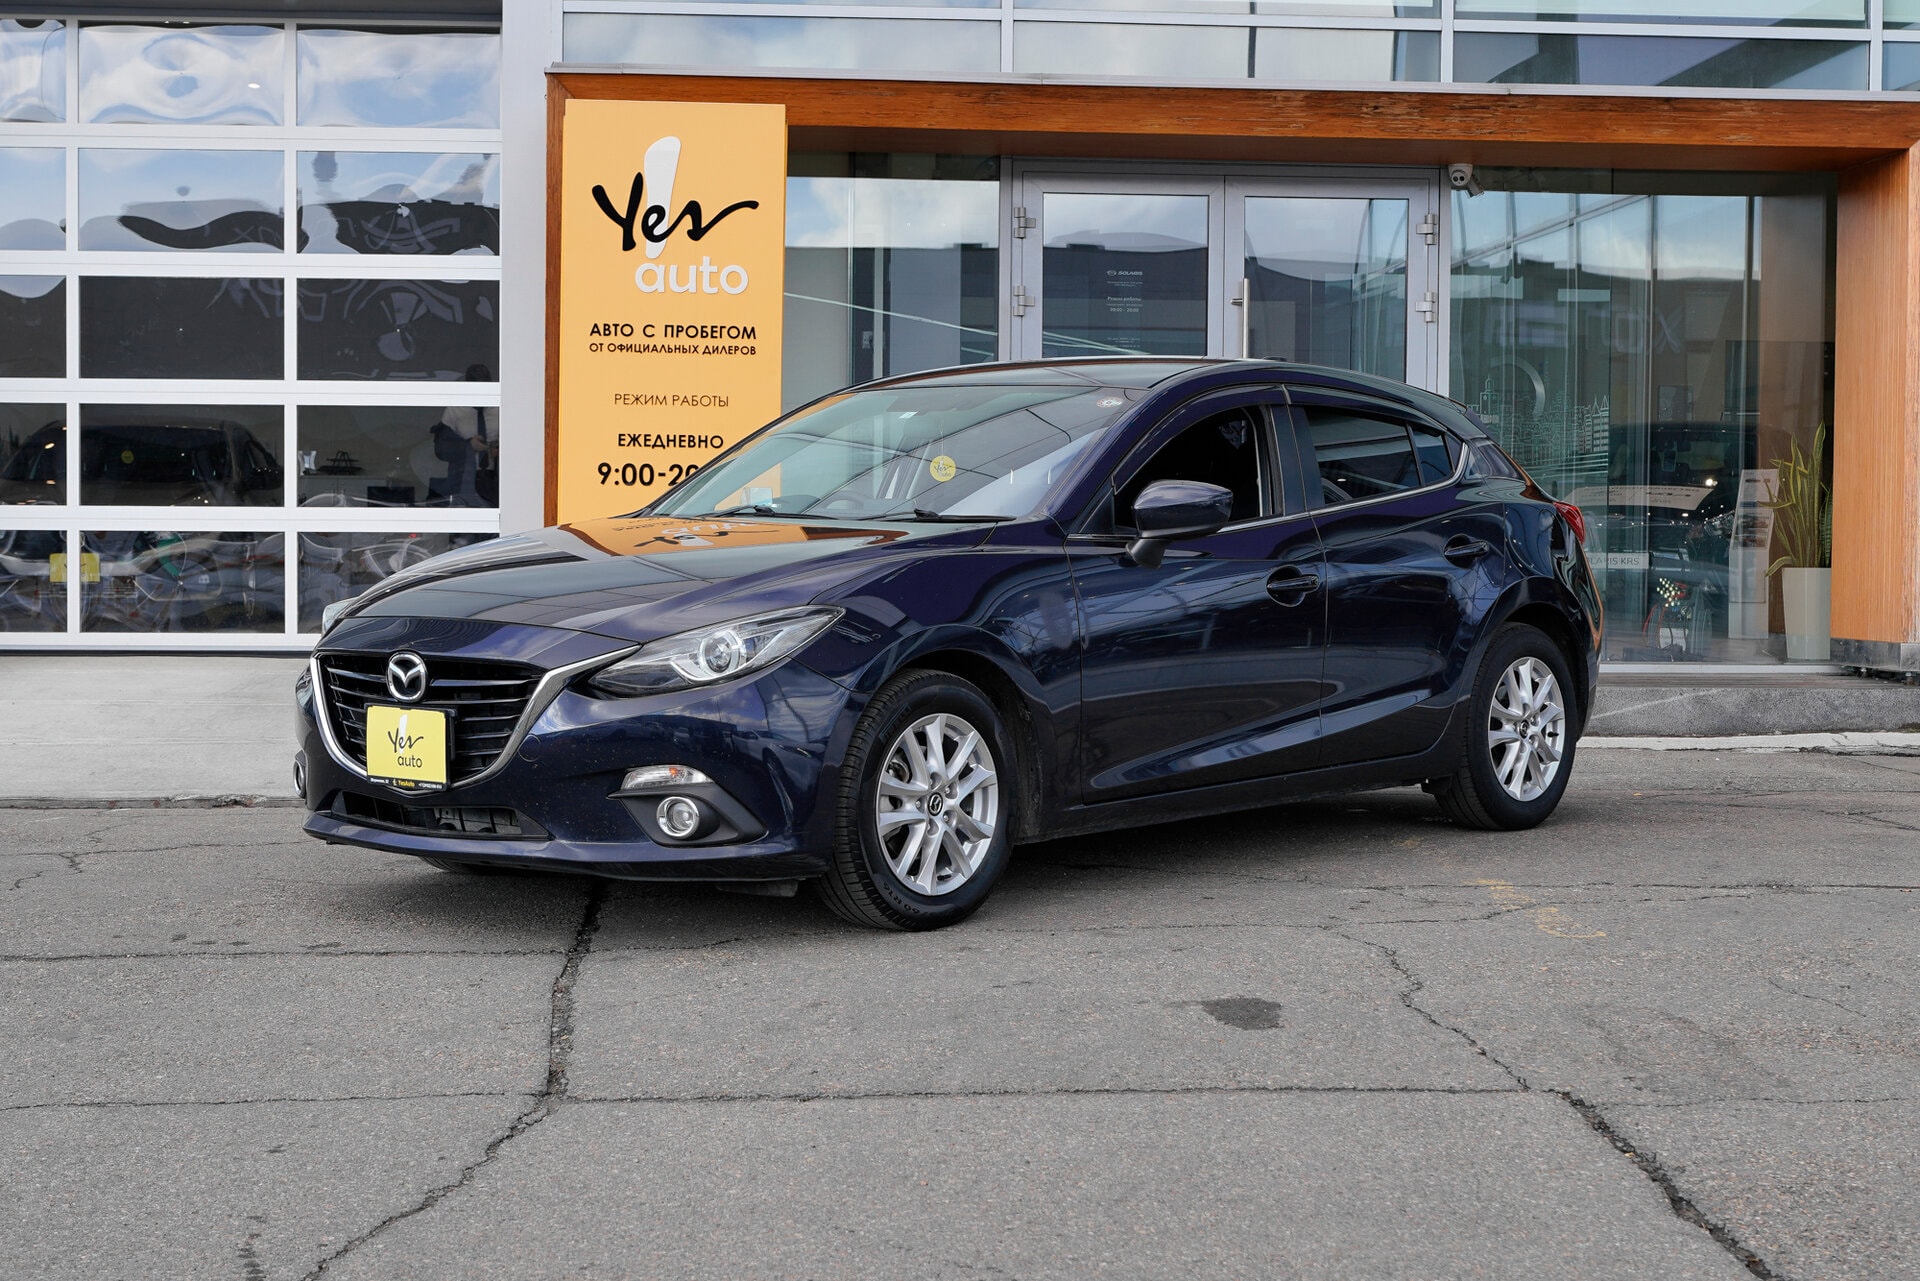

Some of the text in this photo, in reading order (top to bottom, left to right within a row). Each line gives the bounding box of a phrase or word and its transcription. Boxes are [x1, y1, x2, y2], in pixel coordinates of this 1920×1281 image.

[592, 172, 759, 251] Yes
[635, 256, 749, 295] auto
[589, 323, 757, 340] АВТО С ПРОБЕГОМ
[589, 343, 757, 355] ОТ ОФИЦИАЛЬНЫХ ДИЛЕРОВ
[614, 393, 729, 407] РЕЖИМ РАБОТЫ
[618, 433, 724, 449] ЕЖЕДНЕВНО
[388, 728, 424, 753] Yes
[397, 755, 423, 768] auto
